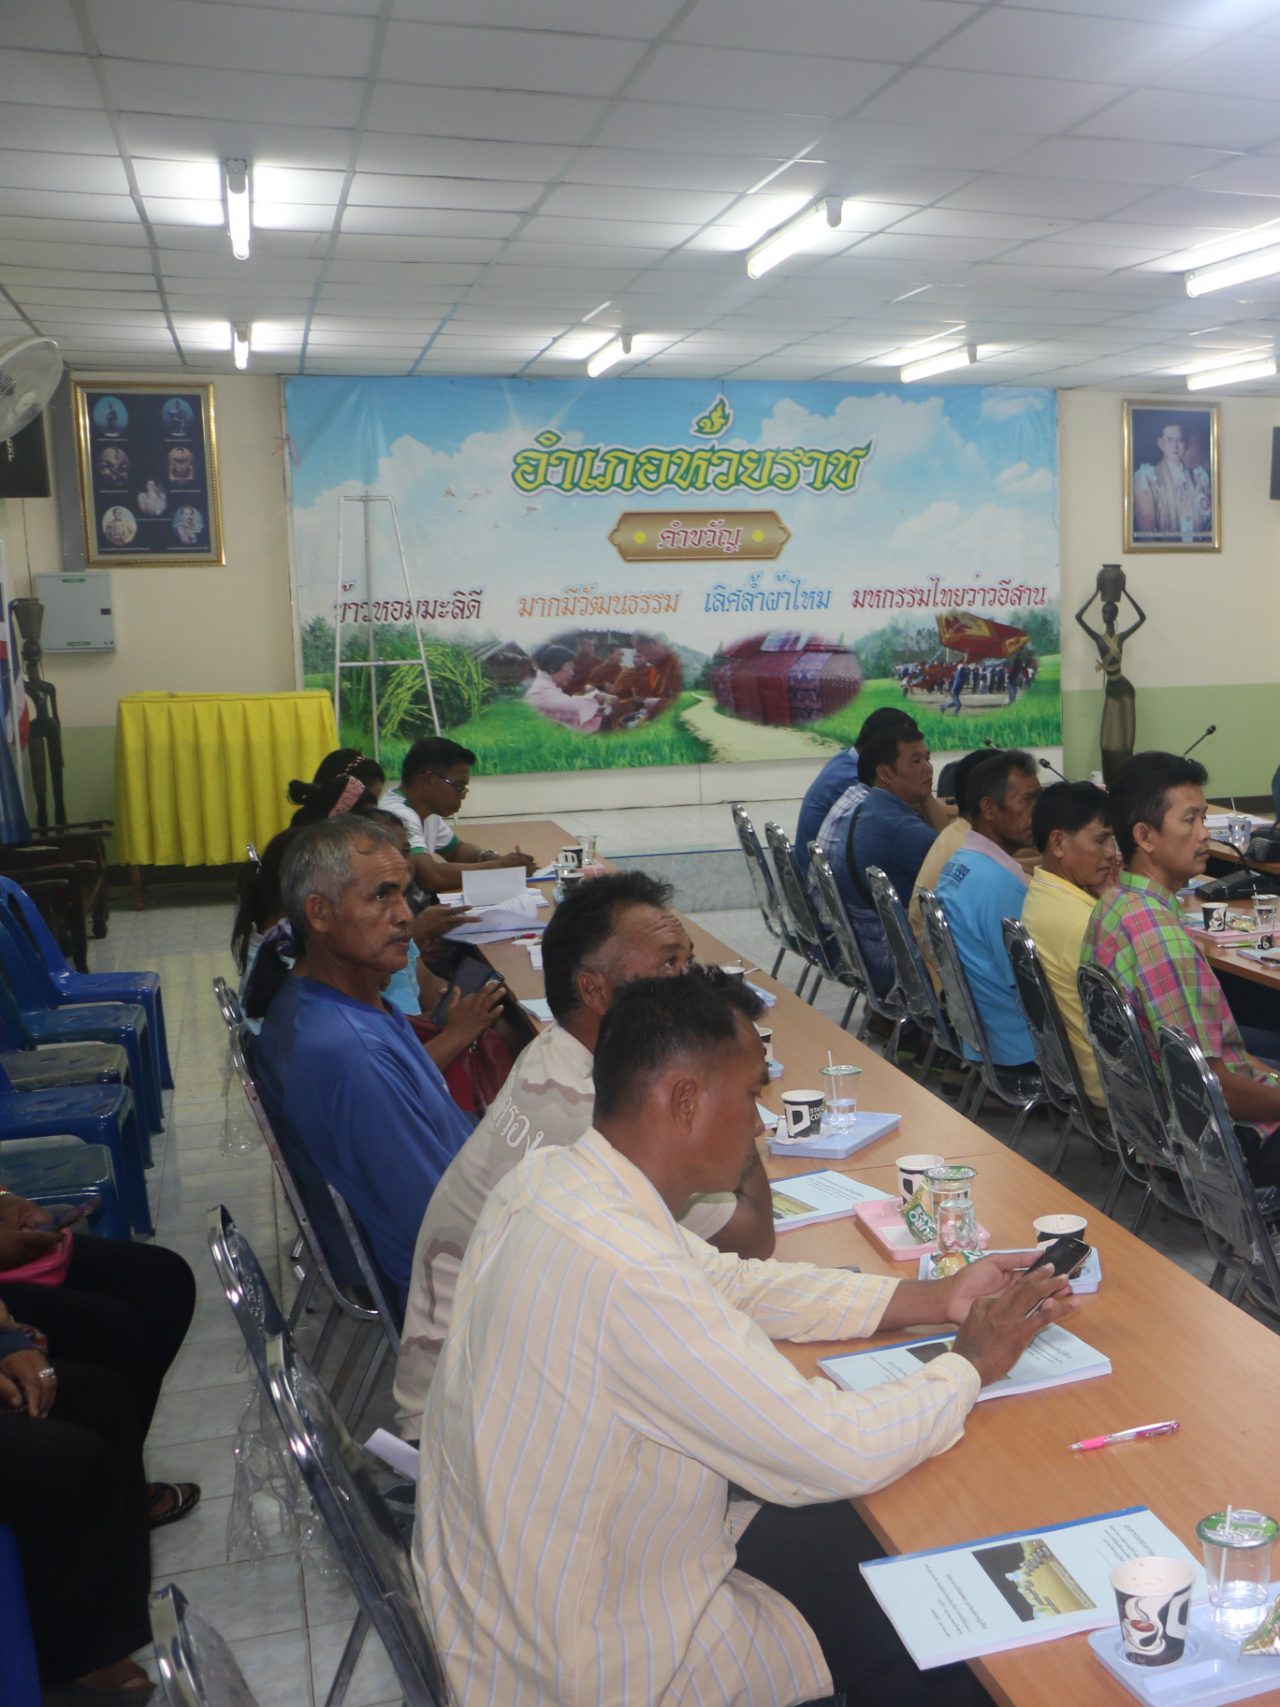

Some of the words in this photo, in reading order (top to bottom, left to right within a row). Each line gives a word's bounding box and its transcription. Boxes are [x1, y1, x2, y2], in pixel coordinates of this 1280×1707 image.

[512, 397, 874, 492] อำเภอห้วยราช
[657, 520, 742, 552] คำขวัญ
[517, 586, 682, 618] มากมีวัฒนธรรม
[704, 573, 832, 613] เลิศล้ำผ้าไหม
[851, 572, 1047, 609] มหกรรมไทยว่าวอีสาน
